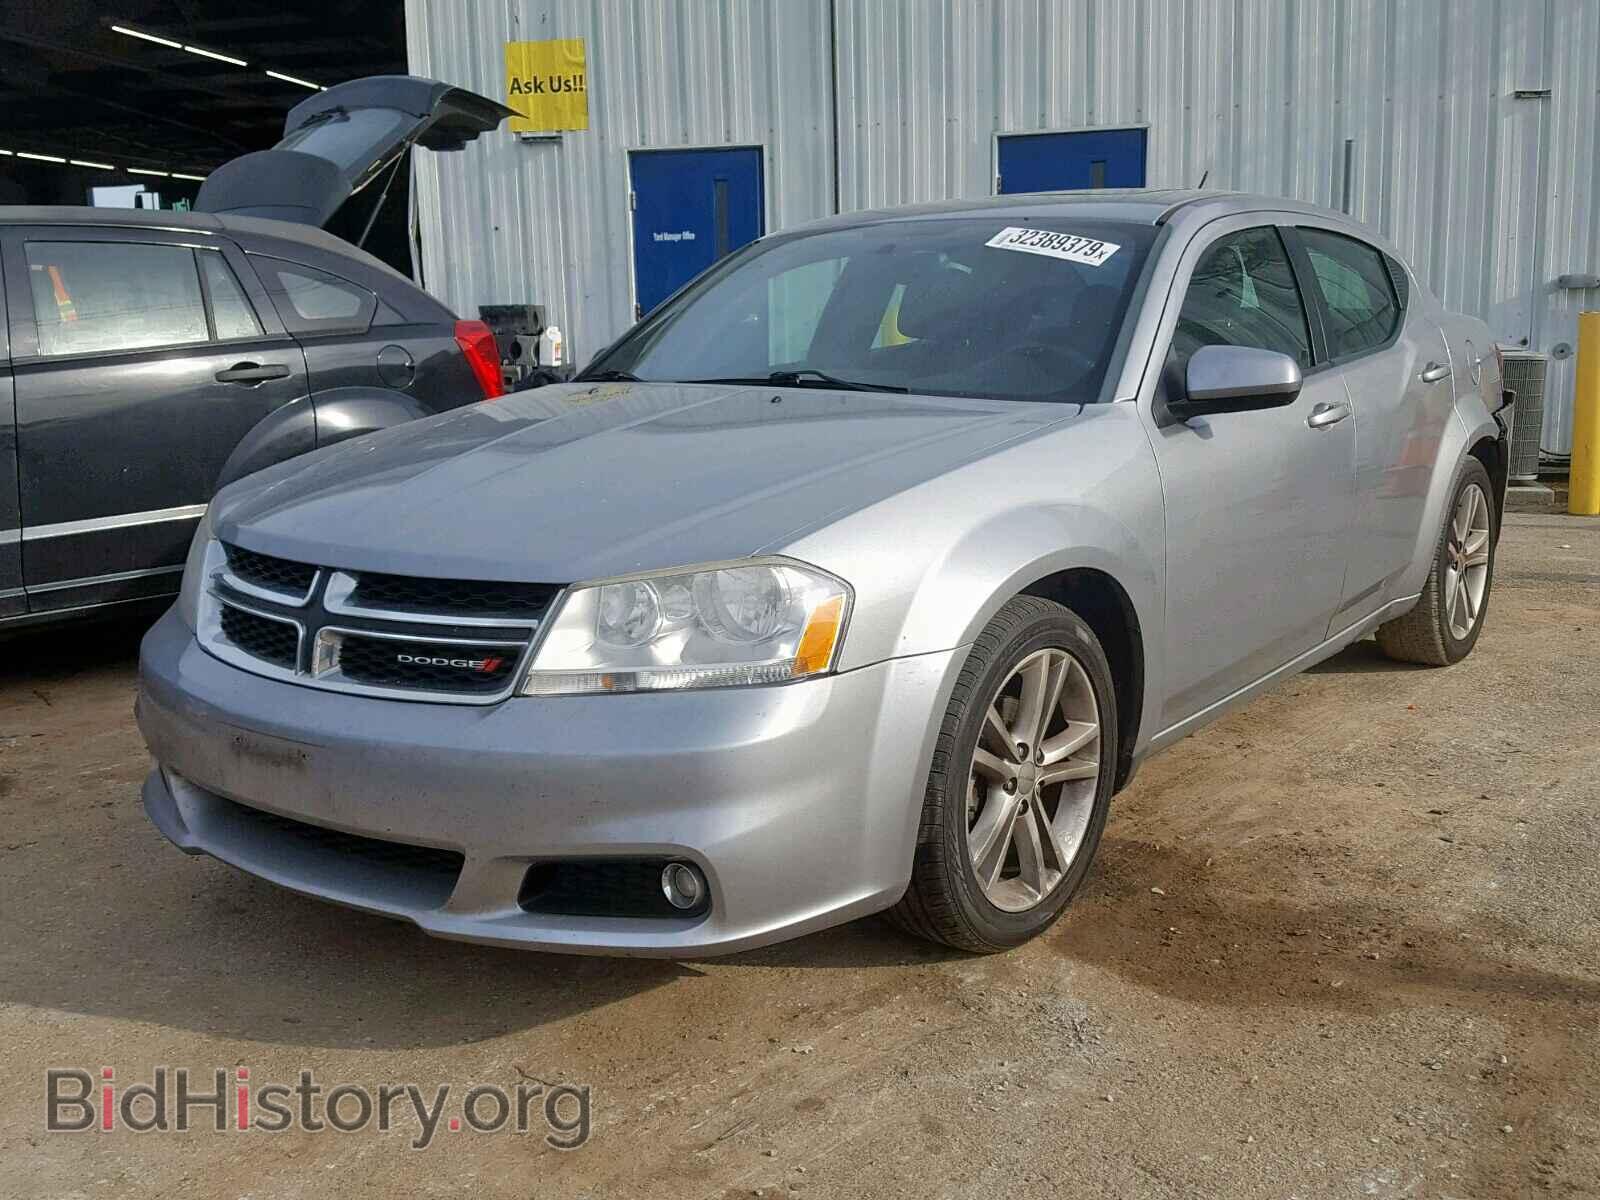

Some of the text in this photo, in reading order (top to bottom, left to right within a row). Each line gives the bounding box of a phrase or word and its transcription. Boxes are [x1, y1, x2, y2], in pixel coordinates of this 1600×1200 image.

[510, 74, 584, 95] Ask Us!!
[397, 654, 486, 668] DODGE
